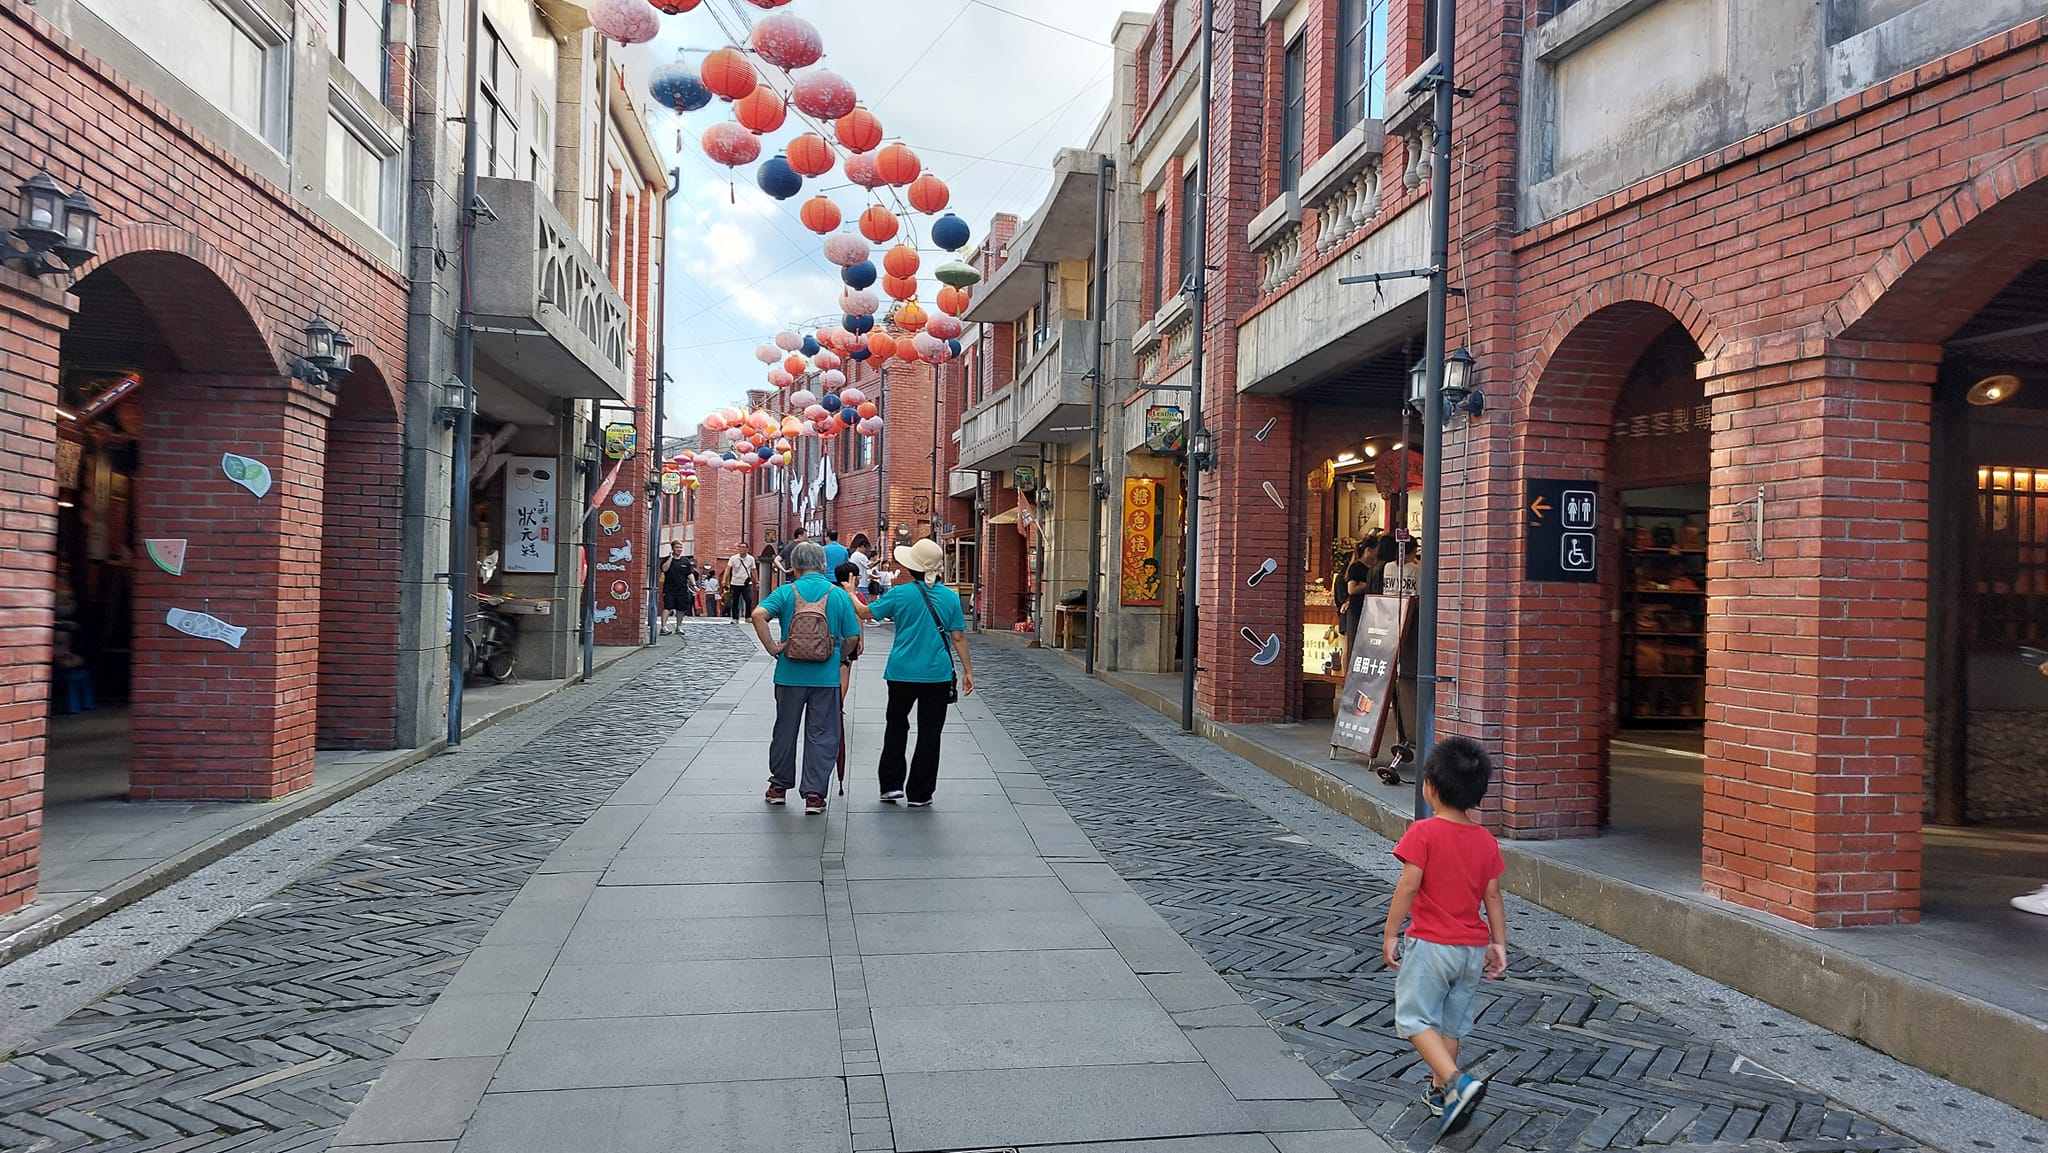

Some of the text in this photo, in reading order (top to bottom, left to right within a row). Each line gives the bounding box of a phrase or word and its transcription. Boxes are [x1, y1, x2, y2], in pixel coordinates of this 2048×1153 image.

[518, 507, 539, 558] 狀元糕
[1385, 577, 1396, 589] EW
